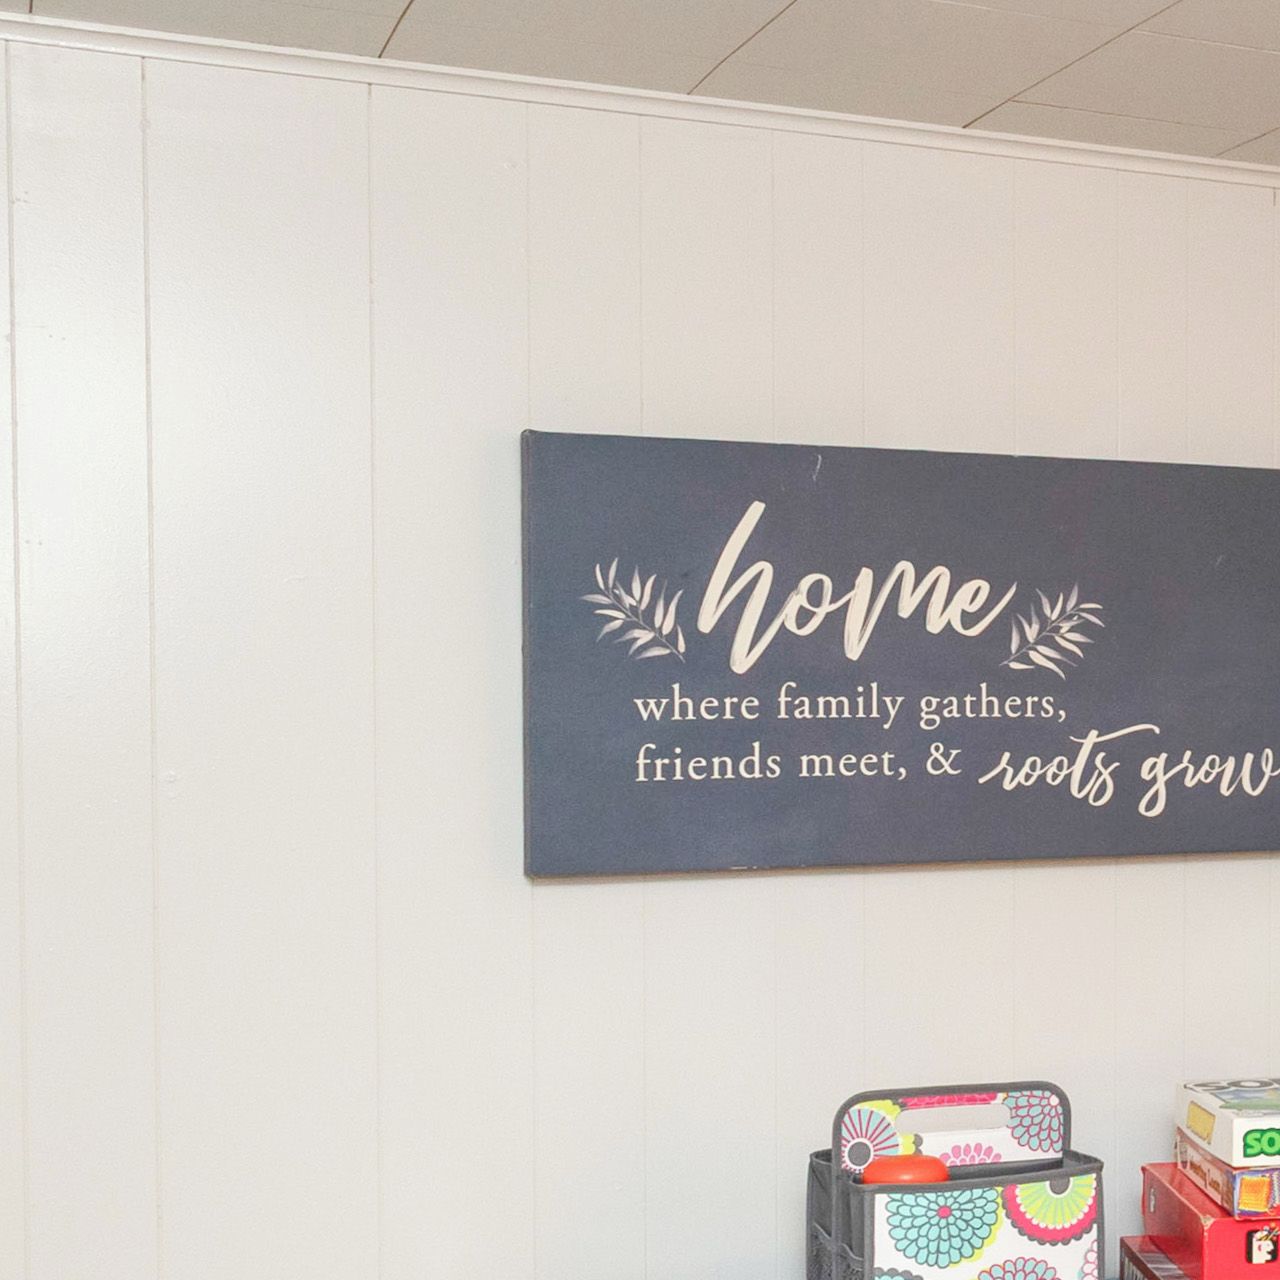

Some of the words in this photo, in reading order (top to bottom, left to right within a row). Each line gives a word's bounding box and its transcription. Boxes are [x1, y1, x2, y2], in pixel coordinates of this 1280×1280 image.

[697, 500, 1016, 674] home
[634, 685, 760, 722] where
[776, 681, 905, 729] family
[919, 683, 1067, 729] gathers,
[634, 741, 782, 782] friends
[799, 747, 907, 781] meet,
[926, 741, 961, 776] &
[977, 723, 1160, 806] roots
